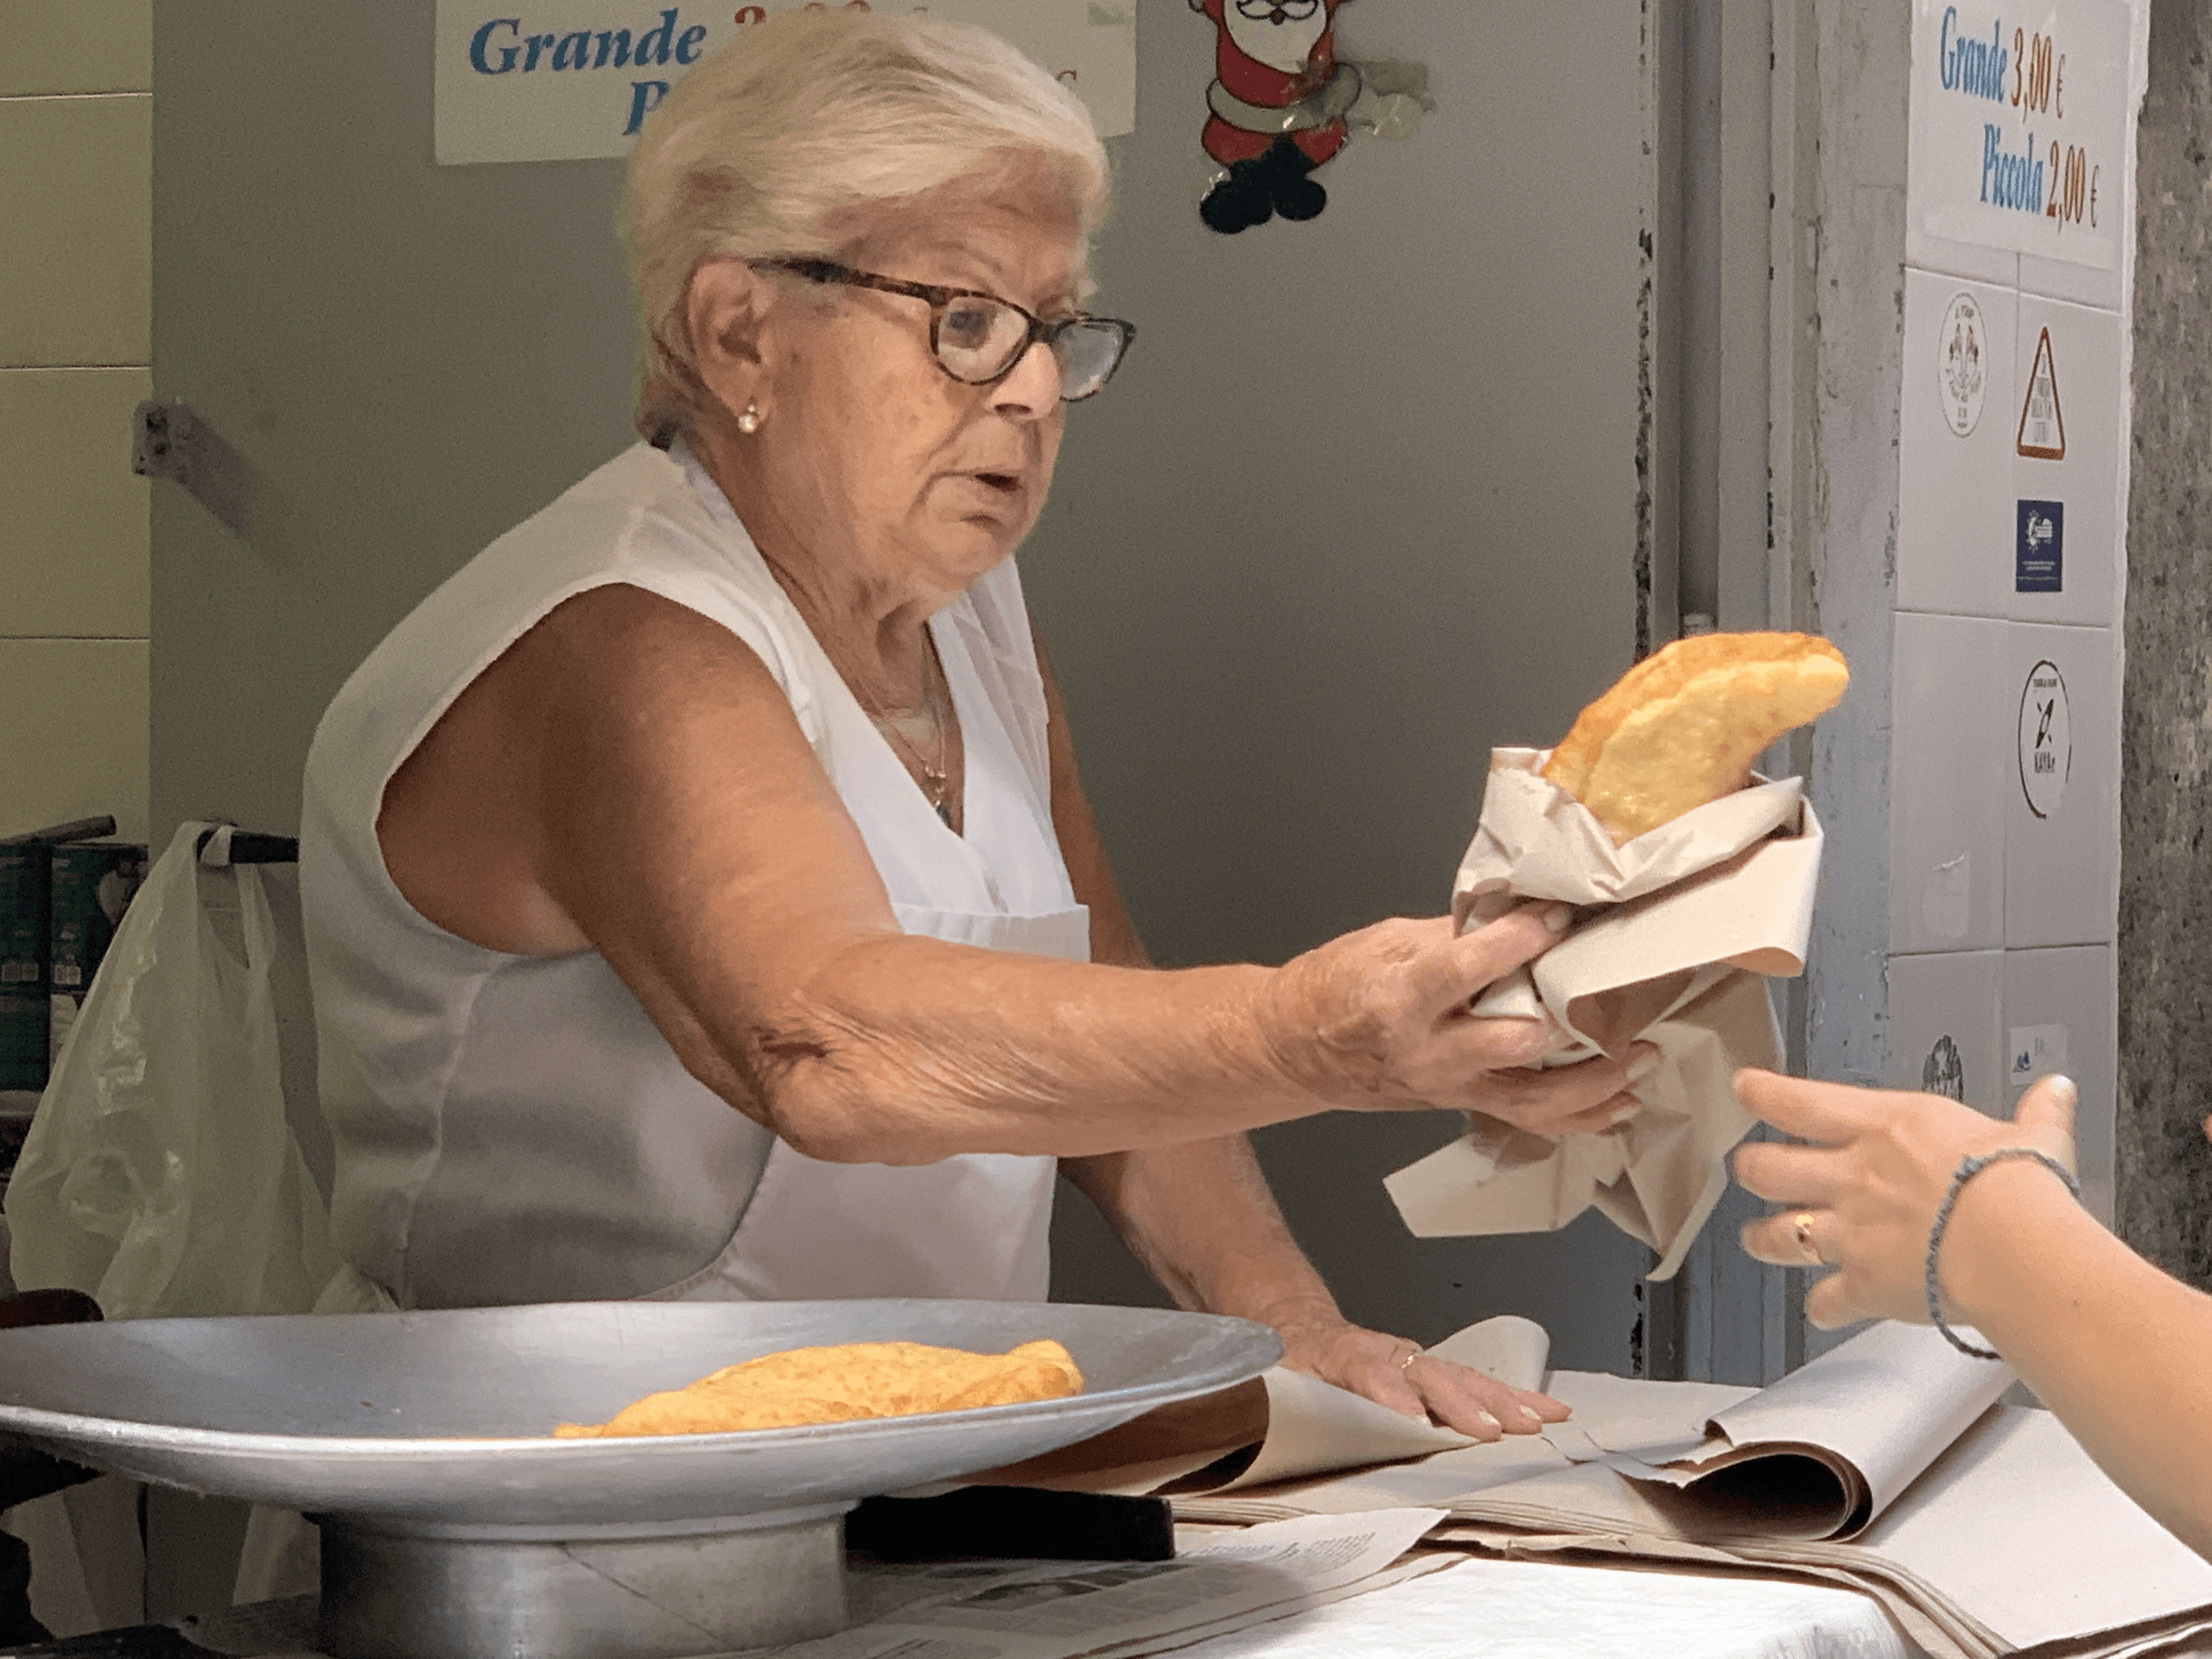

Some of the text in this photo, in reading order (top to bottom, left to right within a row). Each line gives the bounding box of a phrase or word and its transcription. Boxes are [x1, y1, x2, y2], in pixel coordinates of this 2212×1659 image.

[470, 8, 707, 75] Grande
[1941, 5, 2007, 104] Grande
[2011, 28, 2051, 124] 3,00
[1980, 123, 2043, 214] Piccola
[2046, 140, 2085, 235] 2,00
